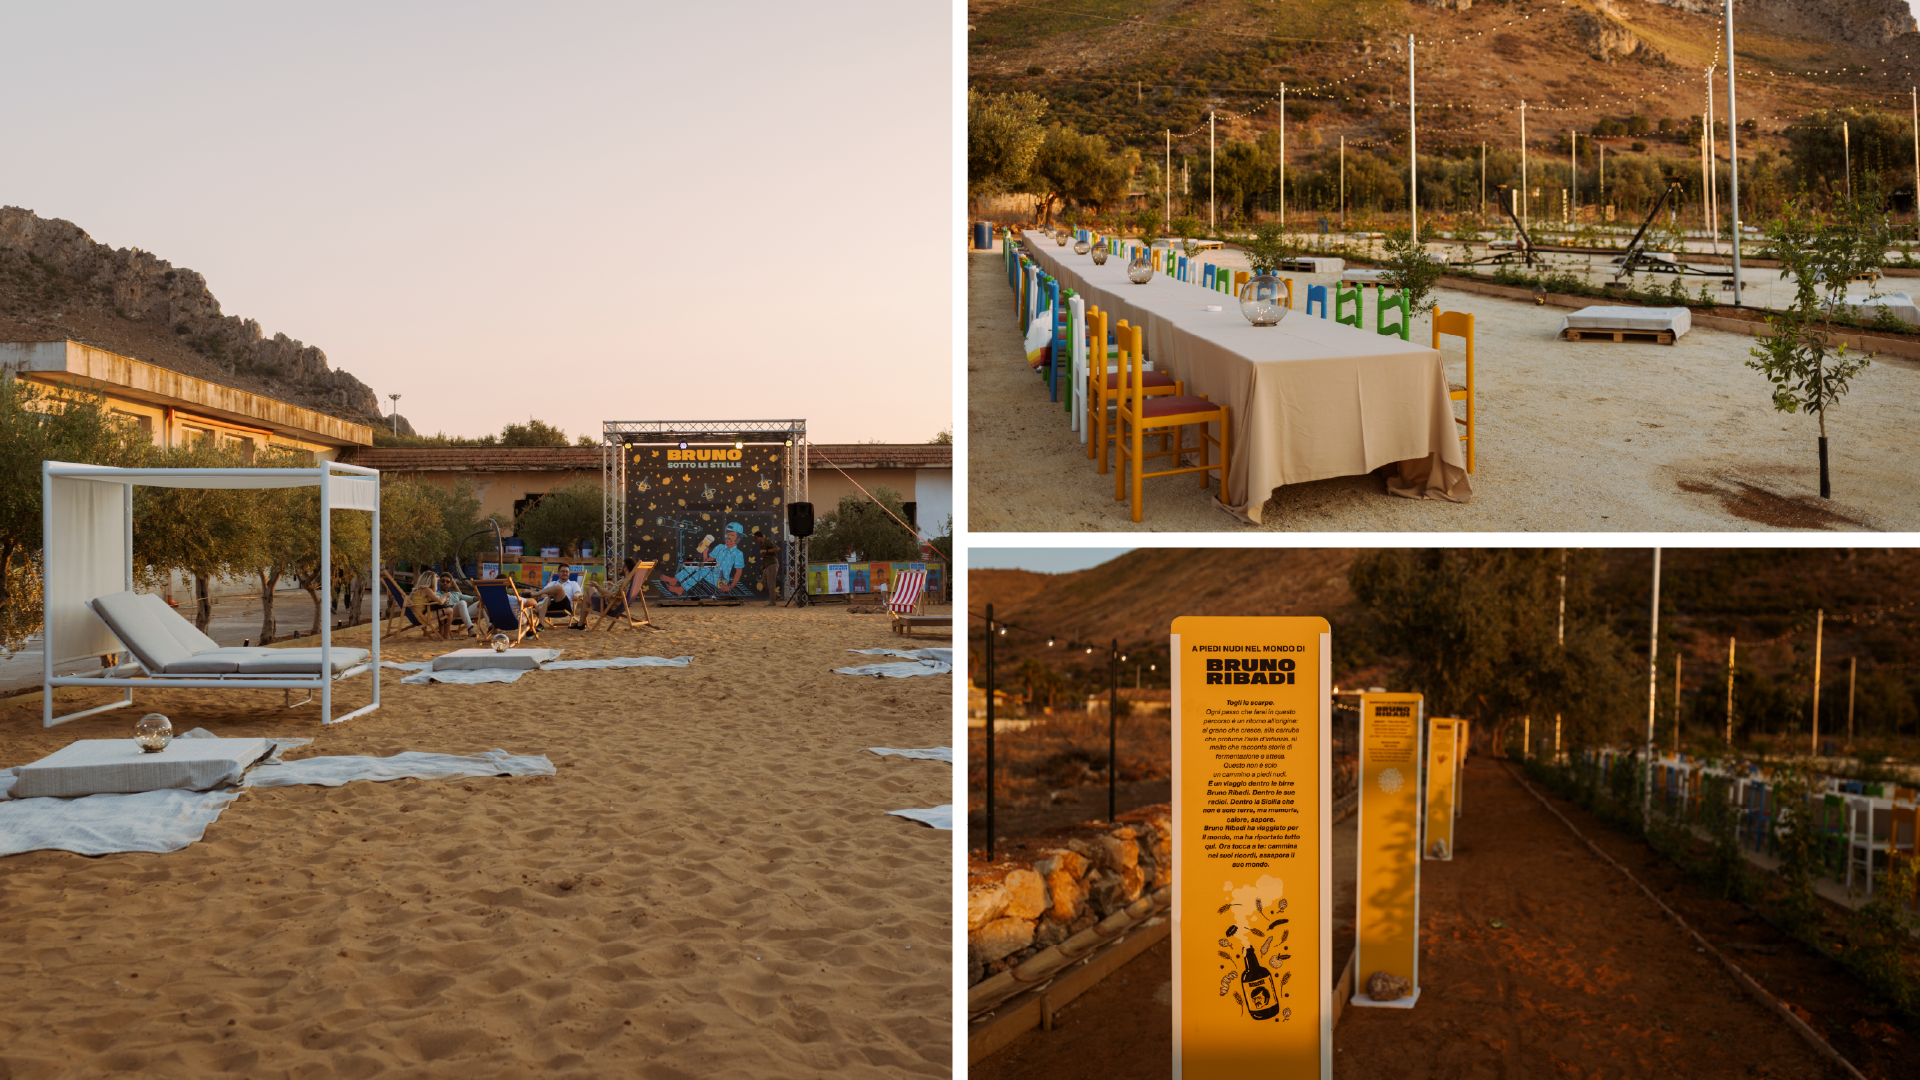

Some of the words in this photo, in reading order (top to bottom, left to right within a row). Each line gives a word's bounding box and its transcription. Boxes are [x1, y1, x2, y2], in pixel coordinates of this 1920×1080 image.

[667, 449, 743, 461] BRUNO
[1207, 658, 1296, 672] BRUNO
[1207, 672, 1295, 685] RIBADI
